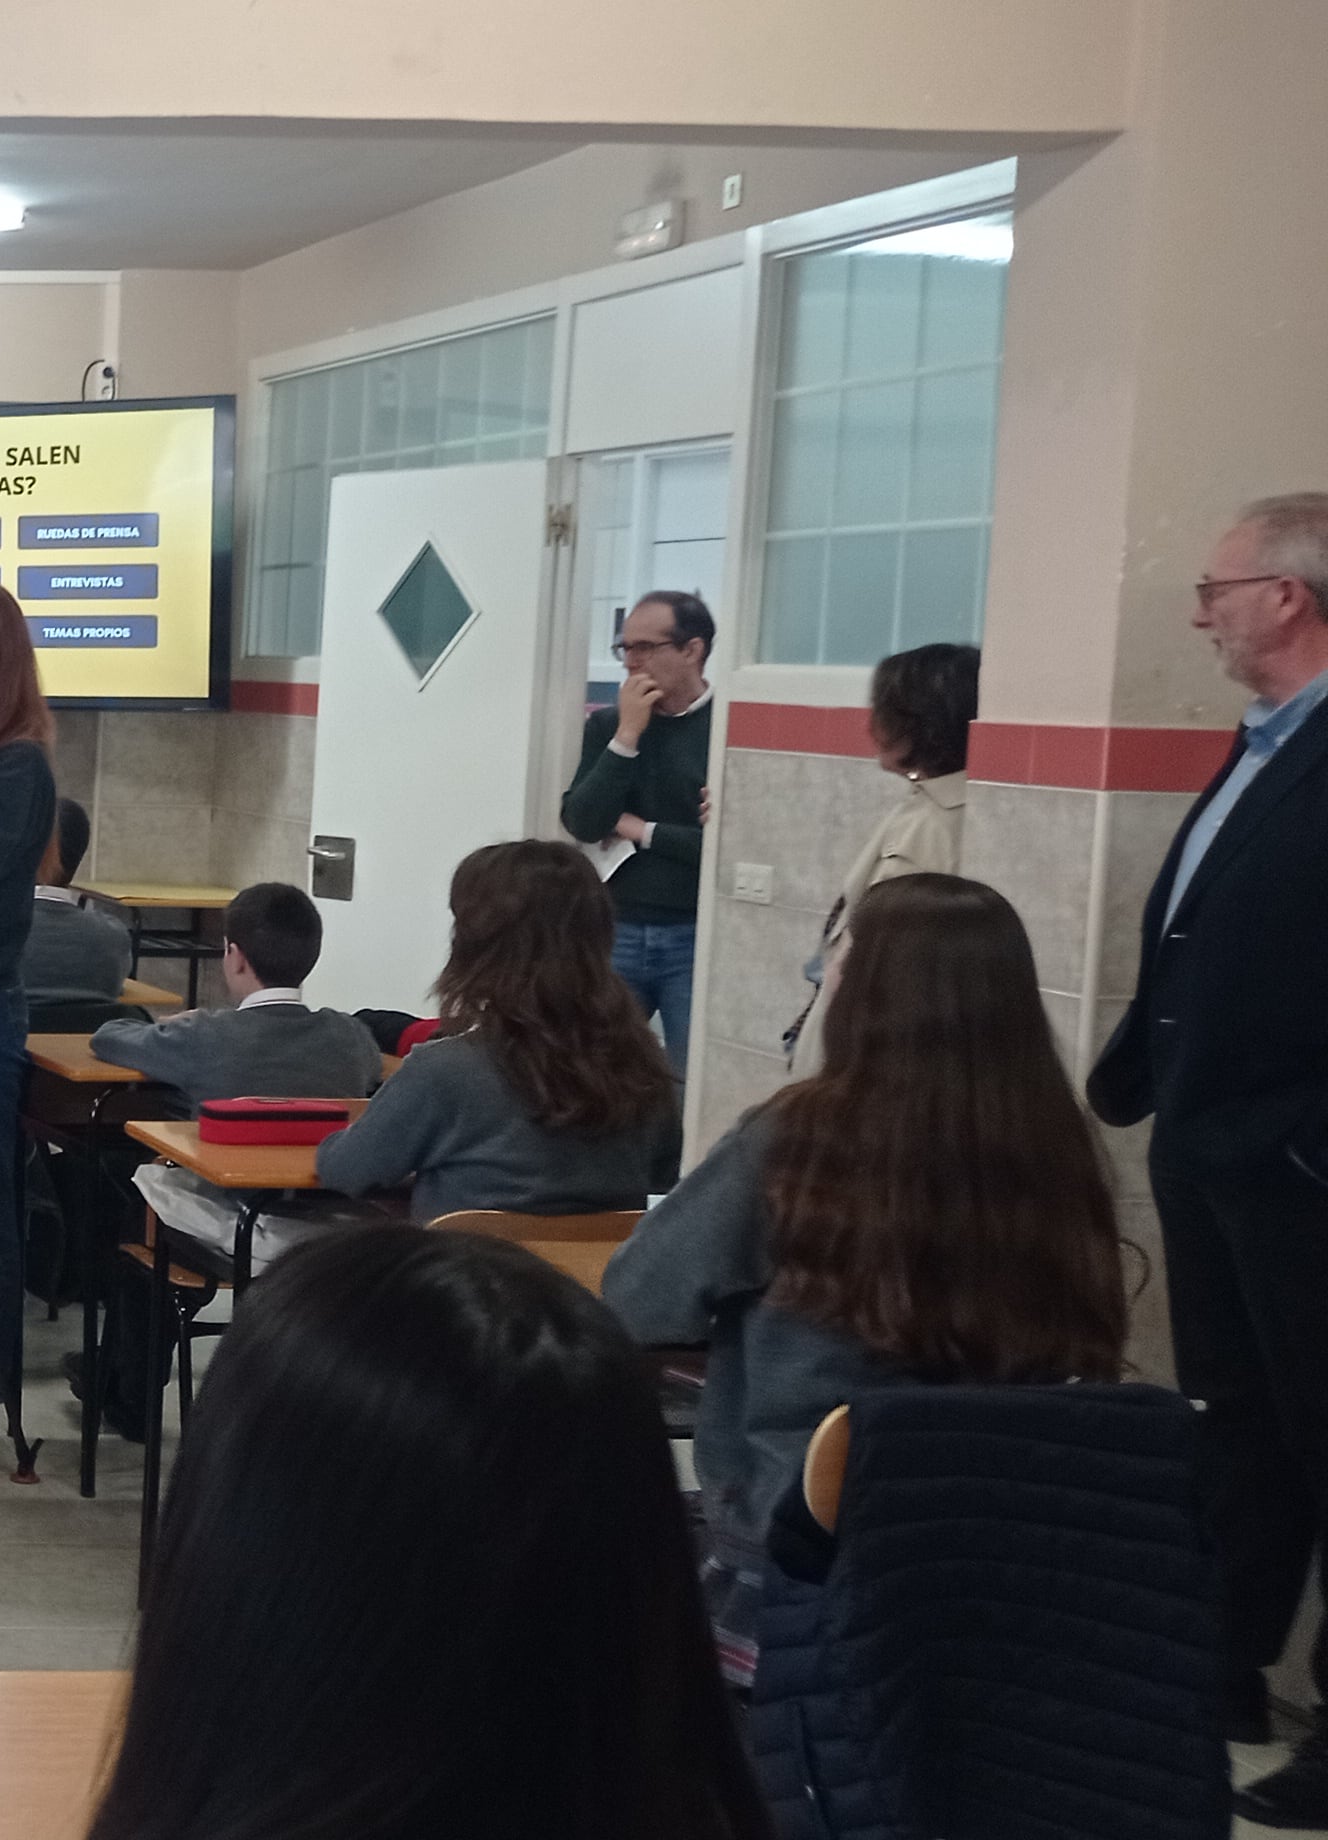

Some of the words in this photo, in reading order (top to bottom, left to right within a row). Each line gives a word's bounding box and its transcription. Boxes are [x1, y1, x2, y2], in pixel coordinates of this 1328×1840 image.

[5, 445, 81, 467] SALEN
[36, 528, 80, 540] RUEDAS
[81, 527, 95, 539] DE
[97, 526, 140, 538] PRENSA
[50, 576, 124, 588] ENTREVISTAS
[42, 627, 81, 638] TEMAS
[82, 627, 131, 638] PROPIOS
